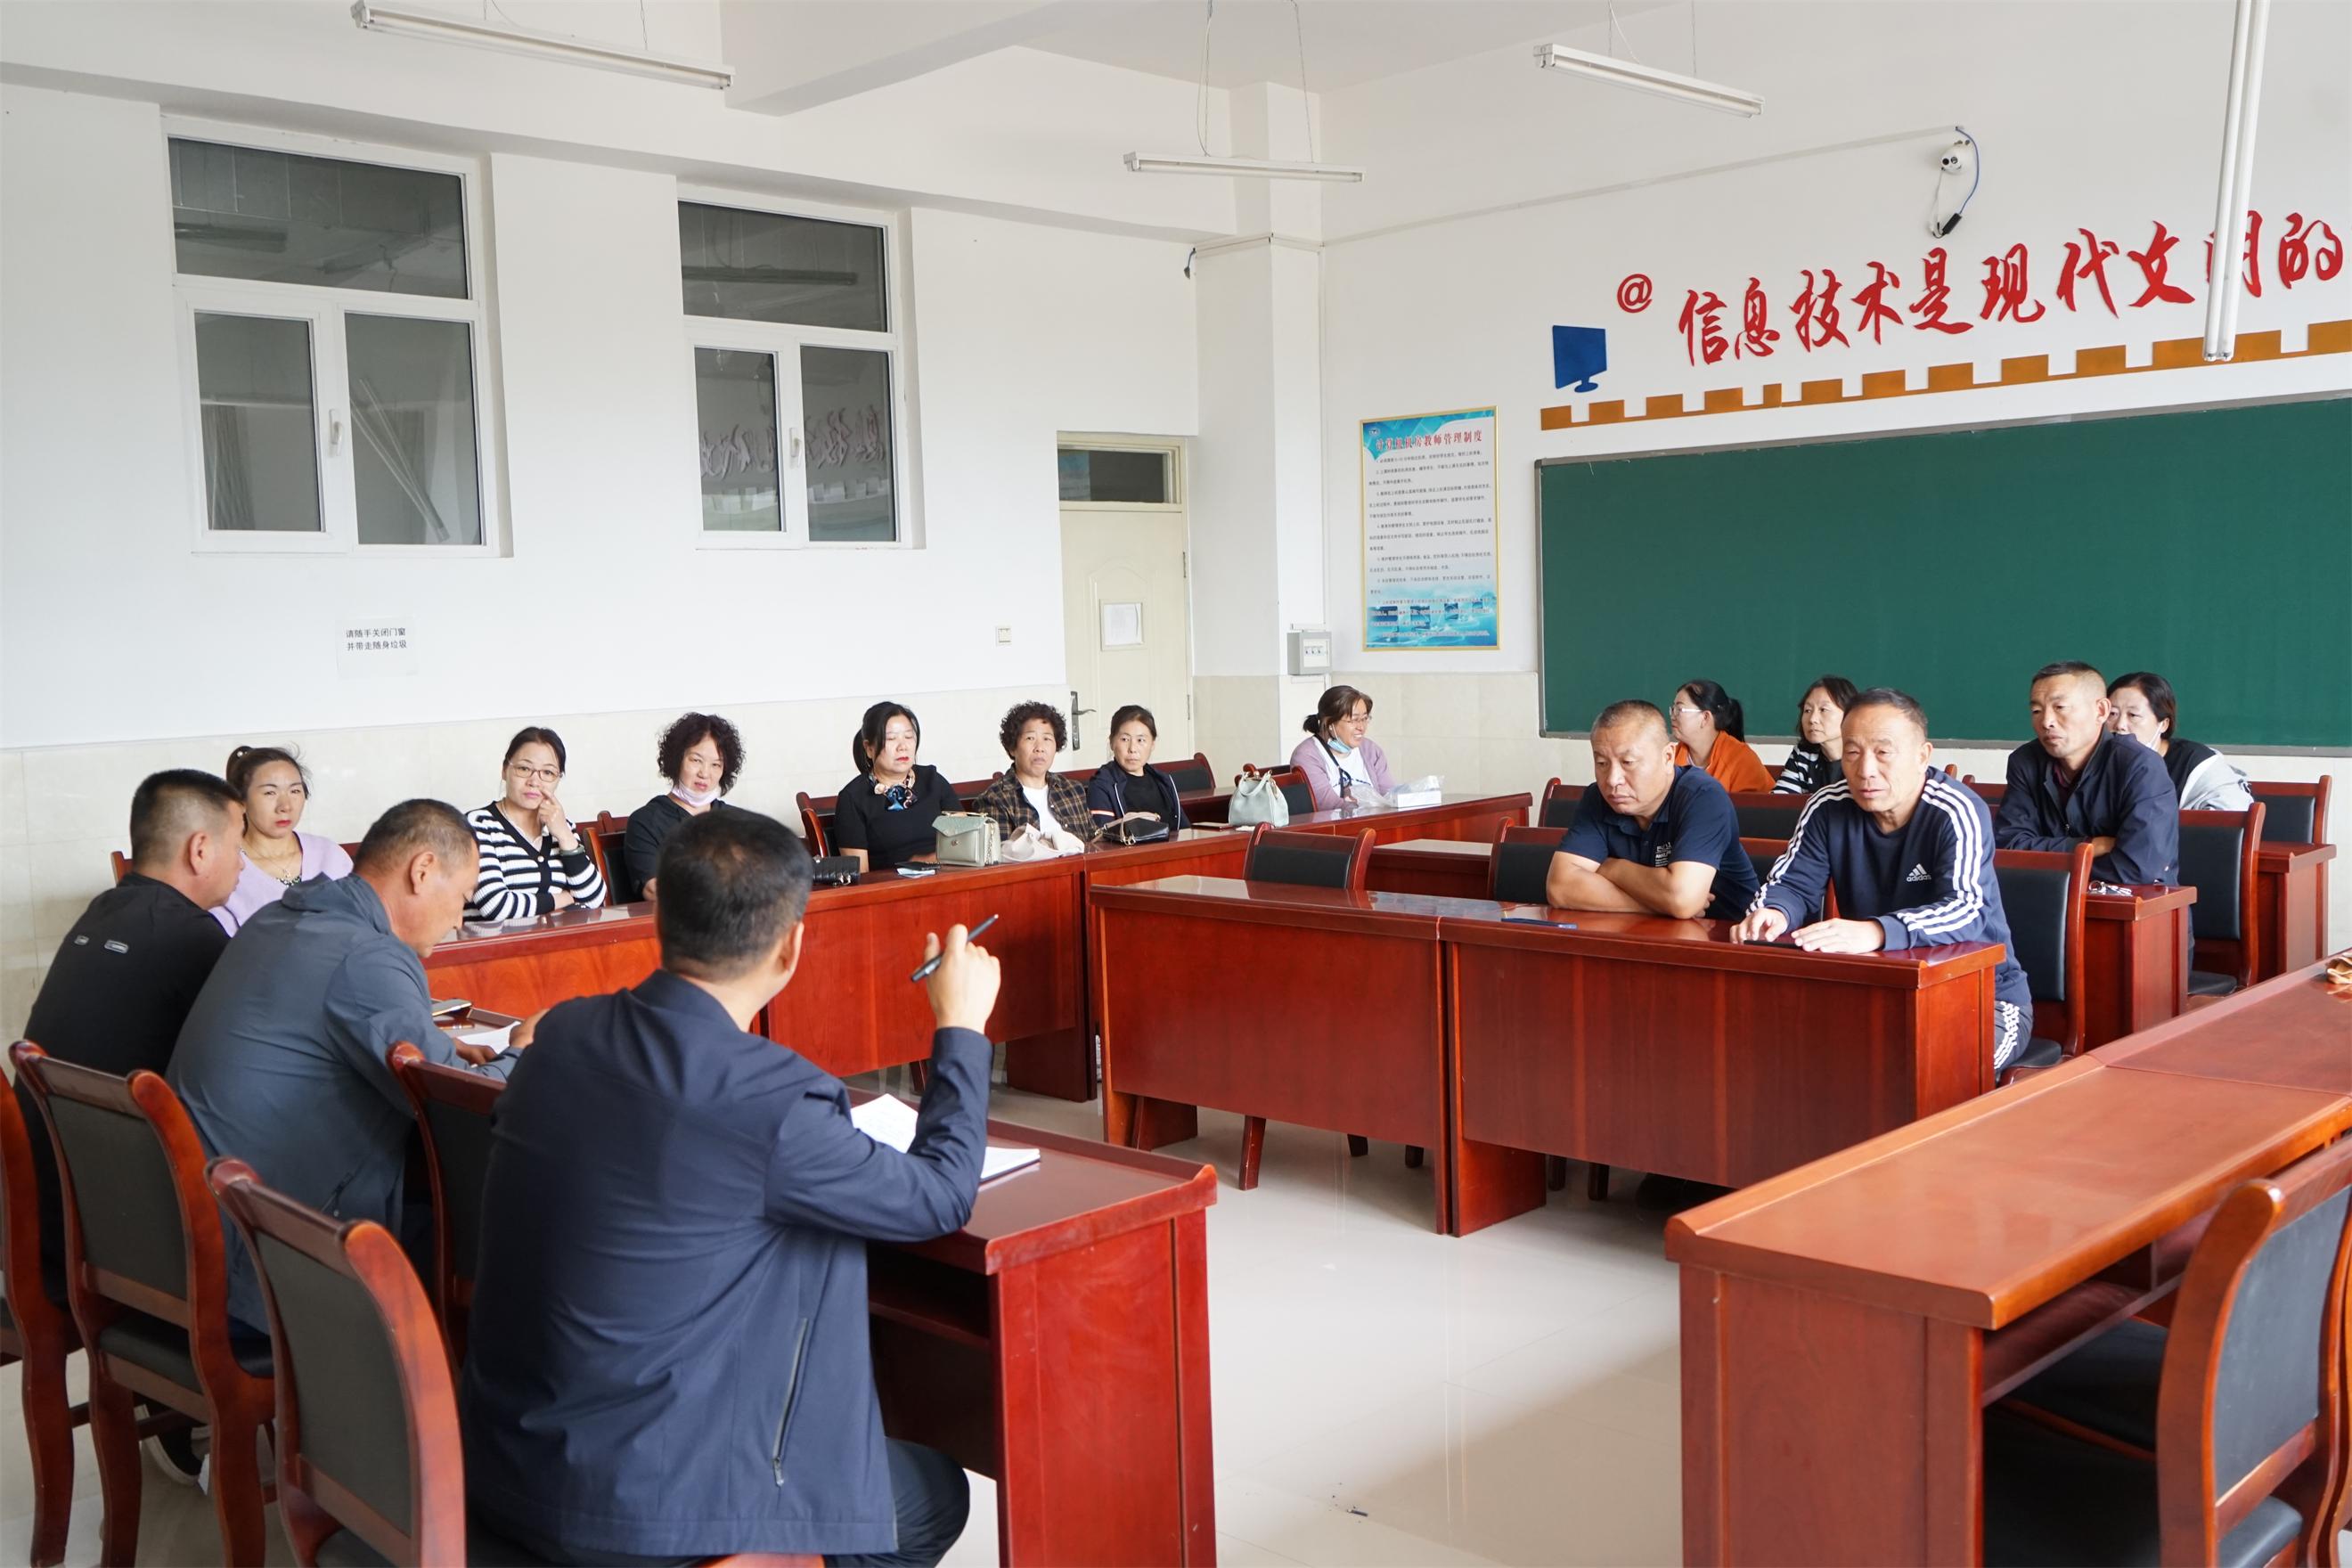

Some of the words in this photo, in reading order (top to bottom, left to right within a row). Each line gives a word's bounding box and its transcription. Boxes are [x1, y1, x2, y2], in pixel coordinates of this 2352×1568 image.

[346, 627, 406, 638] 请随手关闭门窗
[347, 640, 407, 651] 并带走随身垃圾
